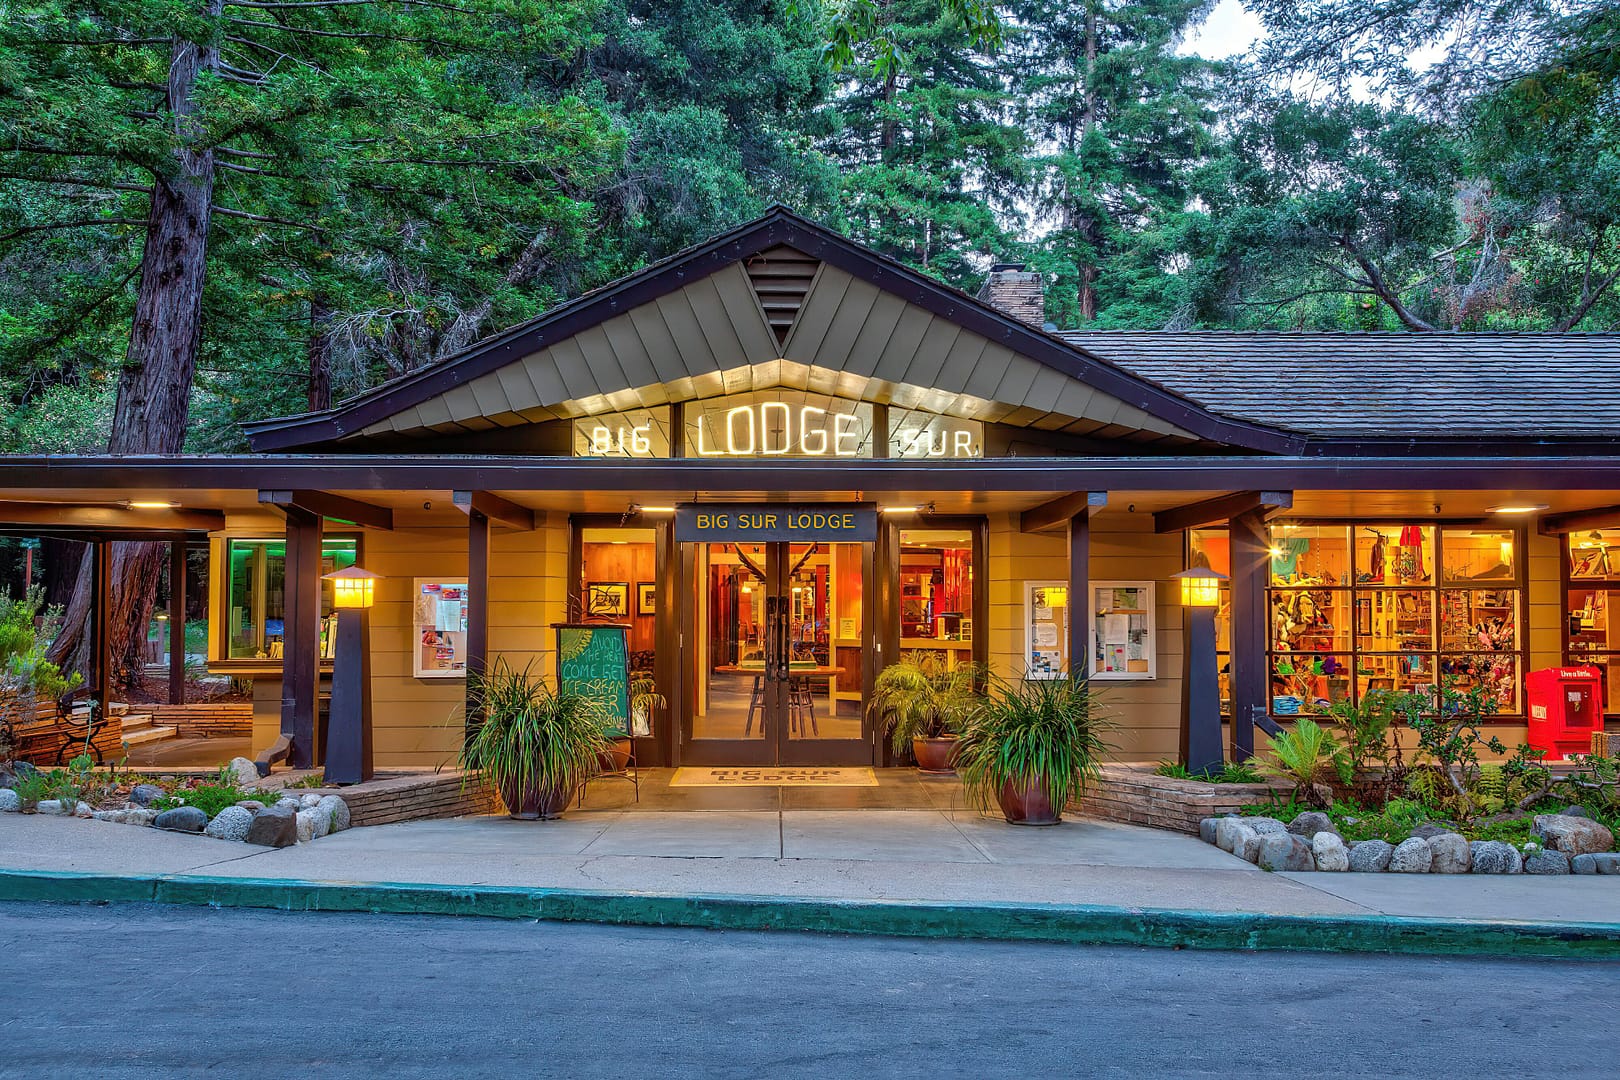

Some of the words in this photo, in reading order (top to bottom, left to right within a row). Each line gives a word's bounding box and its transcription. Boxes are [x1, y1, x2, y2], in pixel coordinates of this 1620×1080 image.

[592, 426, 651, 454] BIG
[697, 401, 859, 456] LODGE
[902, 428, 976, 457] SUR
[696, 513, 730, 530] BIG
[737, 513, 778, 530] SUR
[787, 513, 857, 530] LODGE
[591, 632, 622, 652] AVOID
[582, 648, 600, 662] THE
[563, 663, 598, 679] COME
[602, 663, 625, 680] GET
